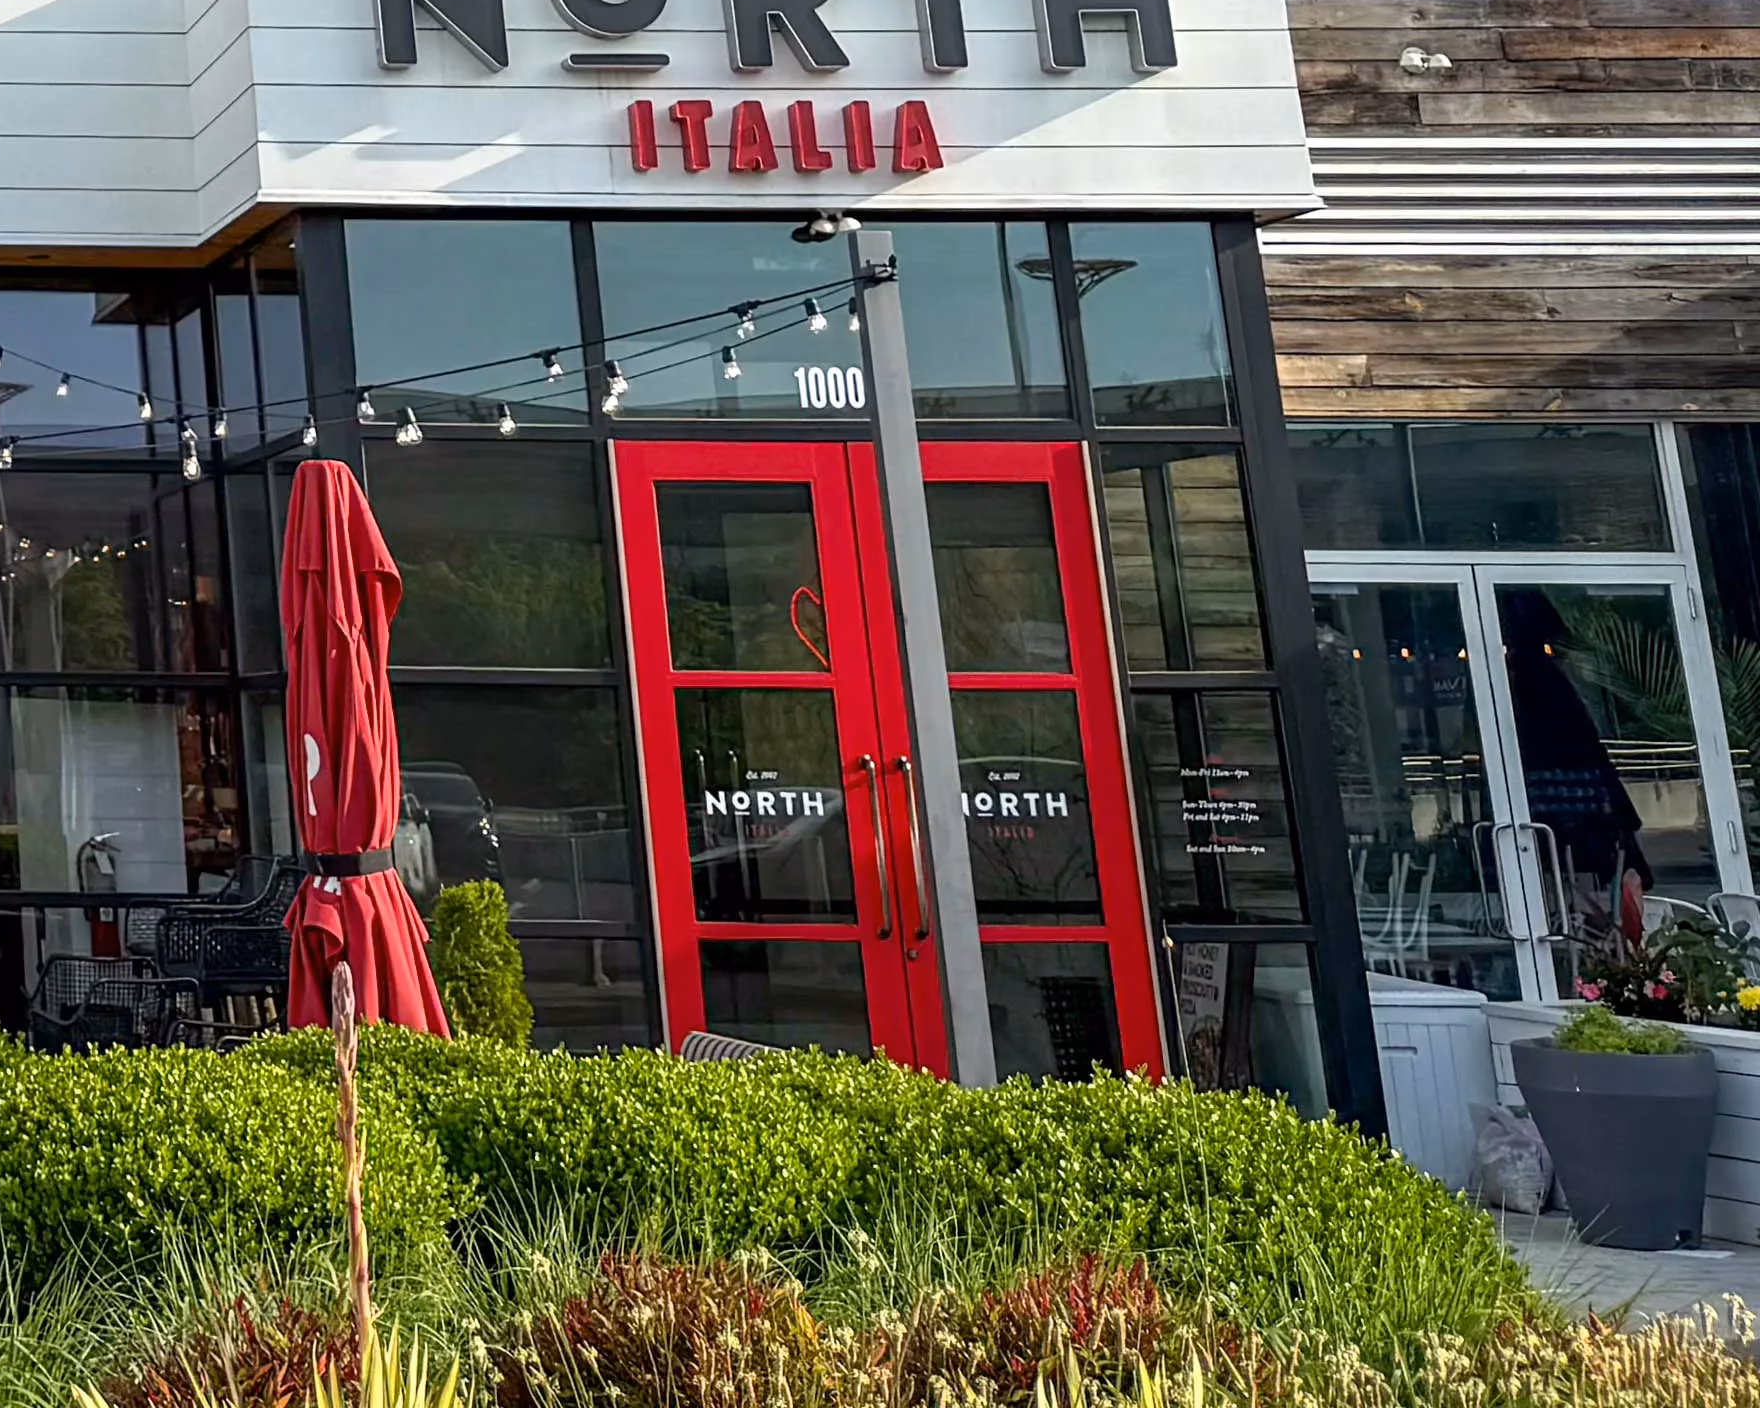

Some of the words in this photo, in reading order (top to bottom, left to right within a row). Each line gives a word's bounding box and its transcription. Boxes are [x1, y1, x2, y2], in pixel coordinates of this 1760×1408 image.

[627, 99, 945, 174] ITALIA
[794, 366, 866, 409] 1000
[705, 790, 824, 816] NORTH
